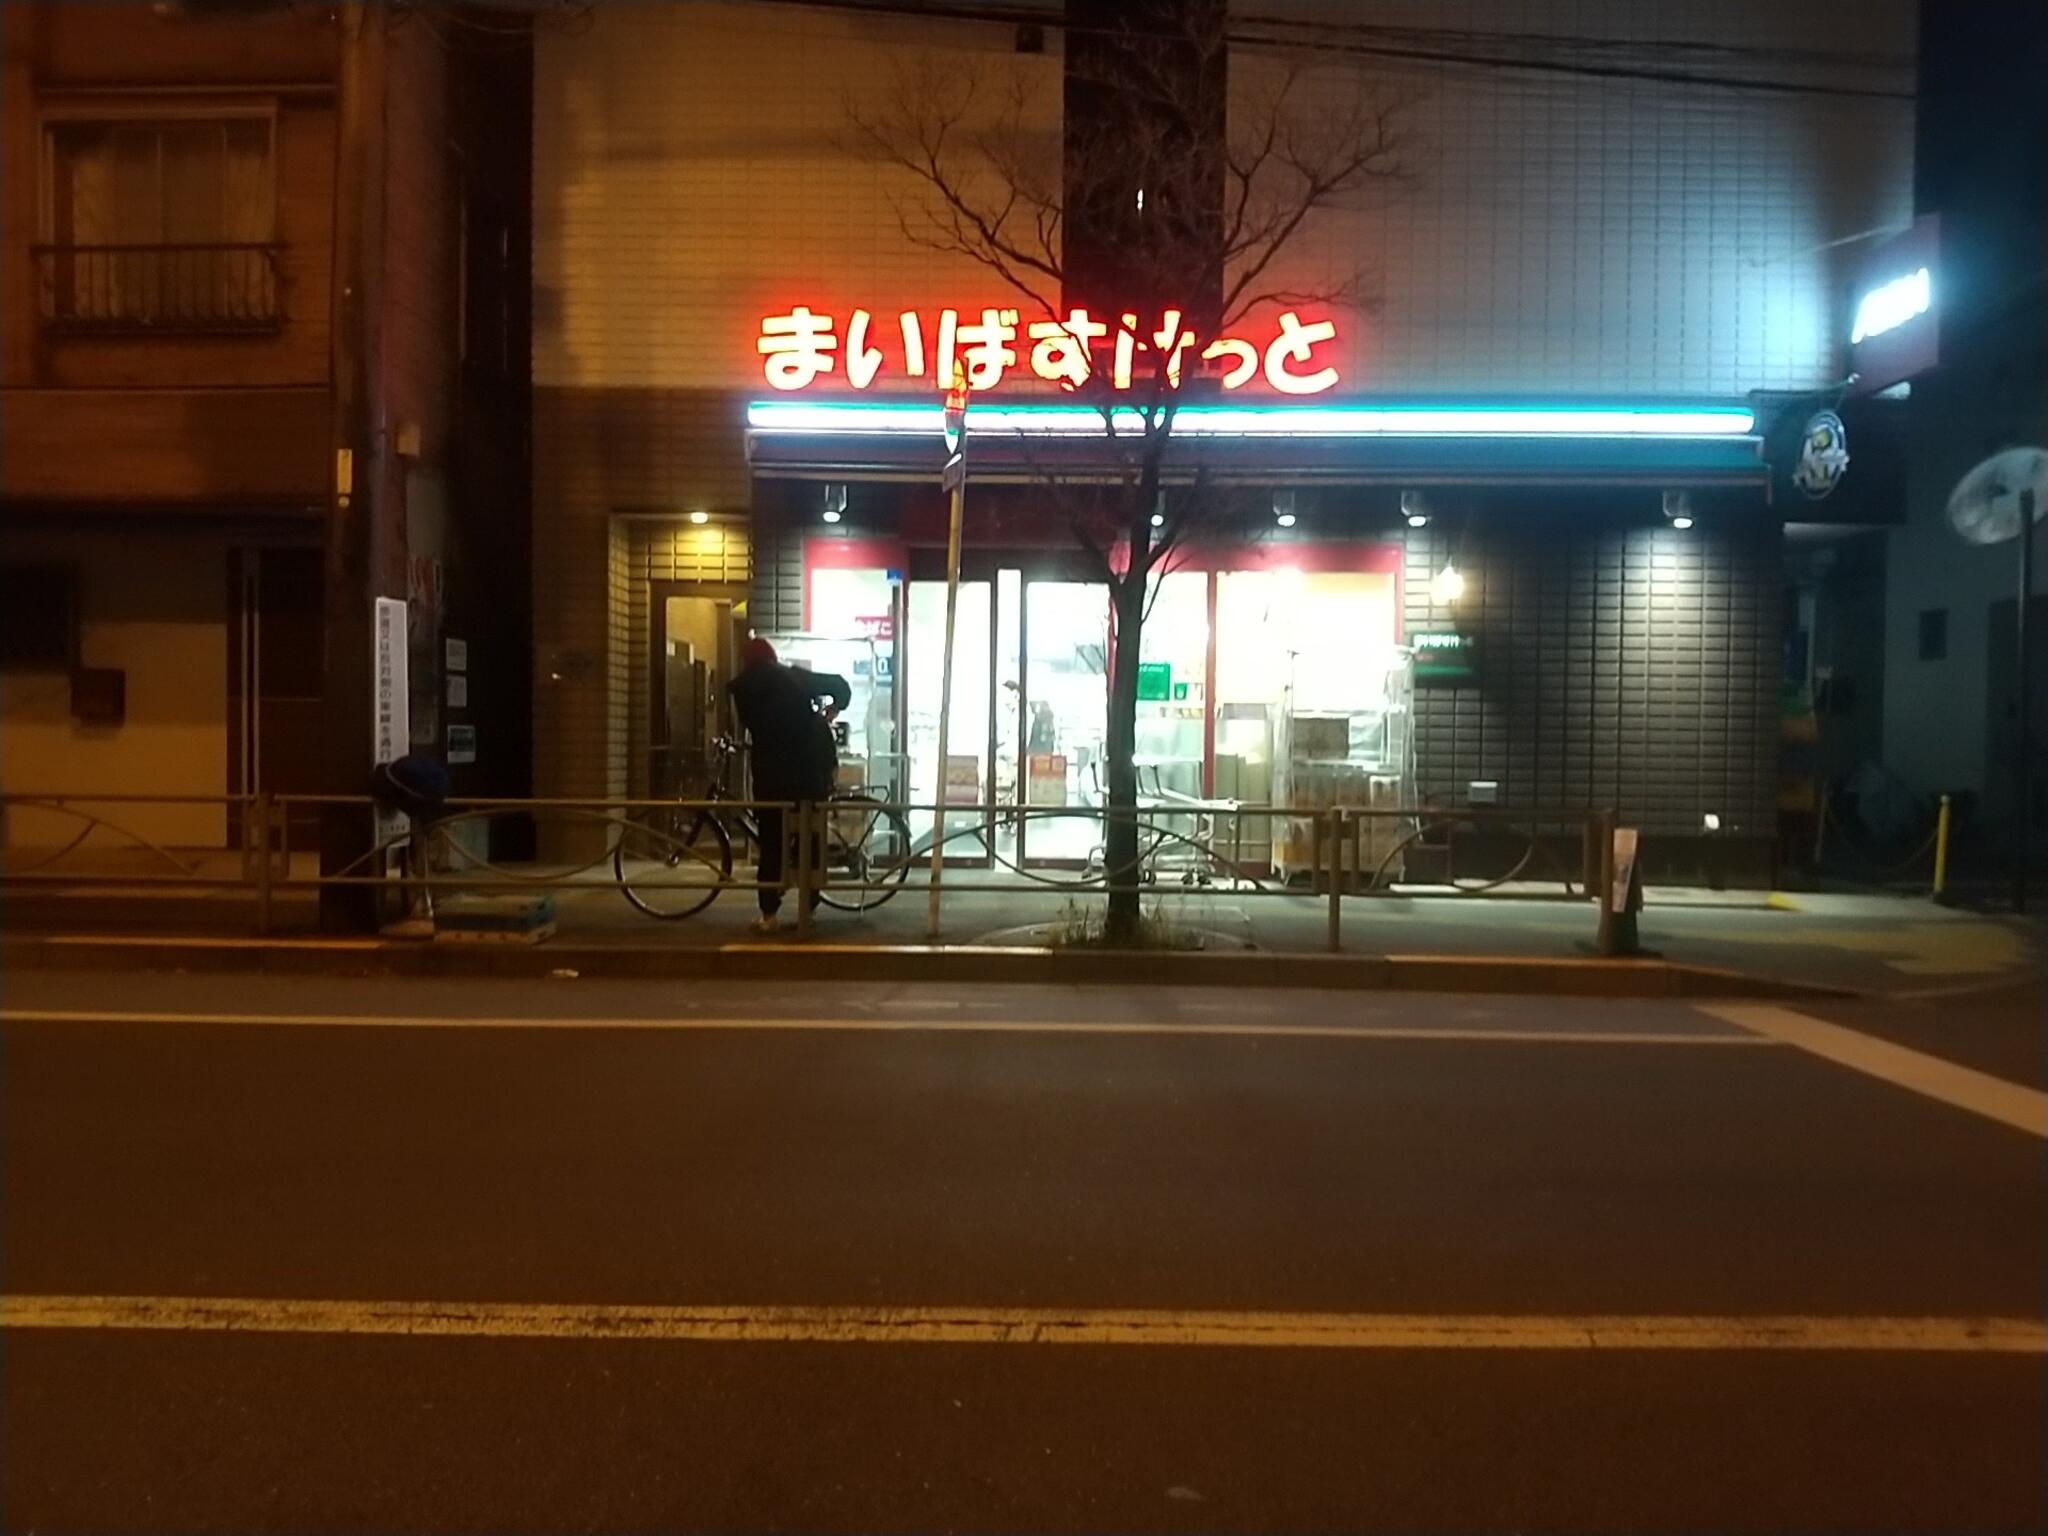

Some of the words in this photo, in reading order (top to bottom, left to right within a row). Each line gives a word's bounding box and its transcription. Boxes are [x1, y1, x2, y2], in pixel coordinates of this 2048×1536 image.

[756, 306, 1340, 395] まいばすけっと
